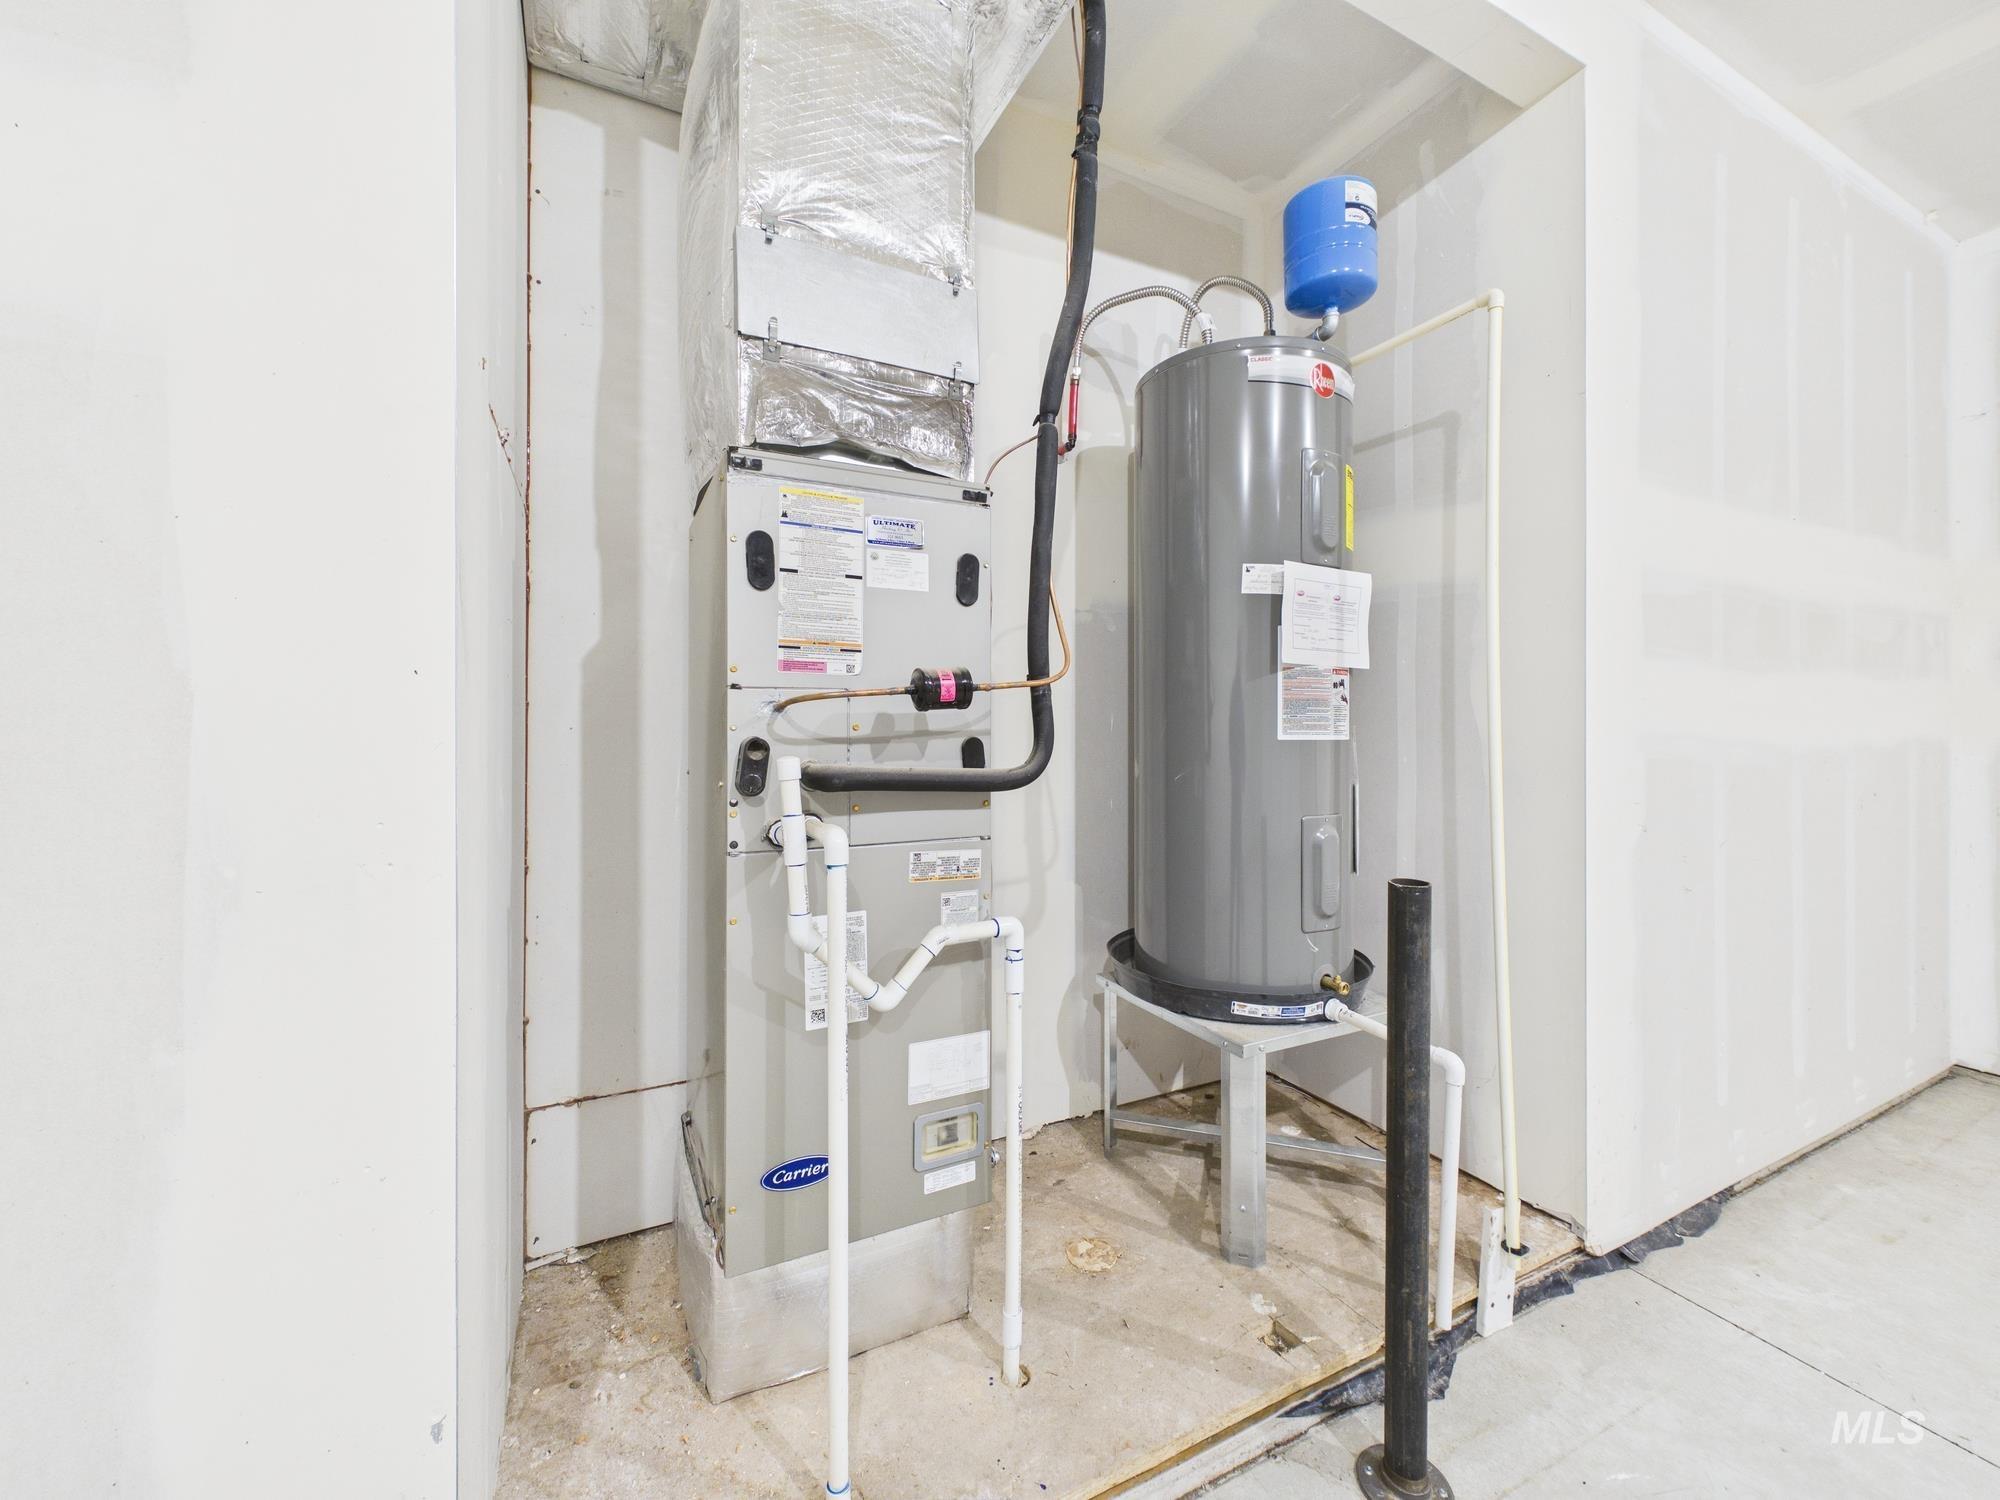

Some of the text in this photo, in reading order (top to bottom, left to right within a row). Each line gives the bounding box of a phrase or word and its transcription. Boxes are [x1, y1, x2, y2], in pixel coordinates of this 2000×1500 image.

[1312, 363, 1335, 393] Rheem
[872, 519, 916, 530] ULTIMATE
[772, 1162, 829, 1185] Carrier
